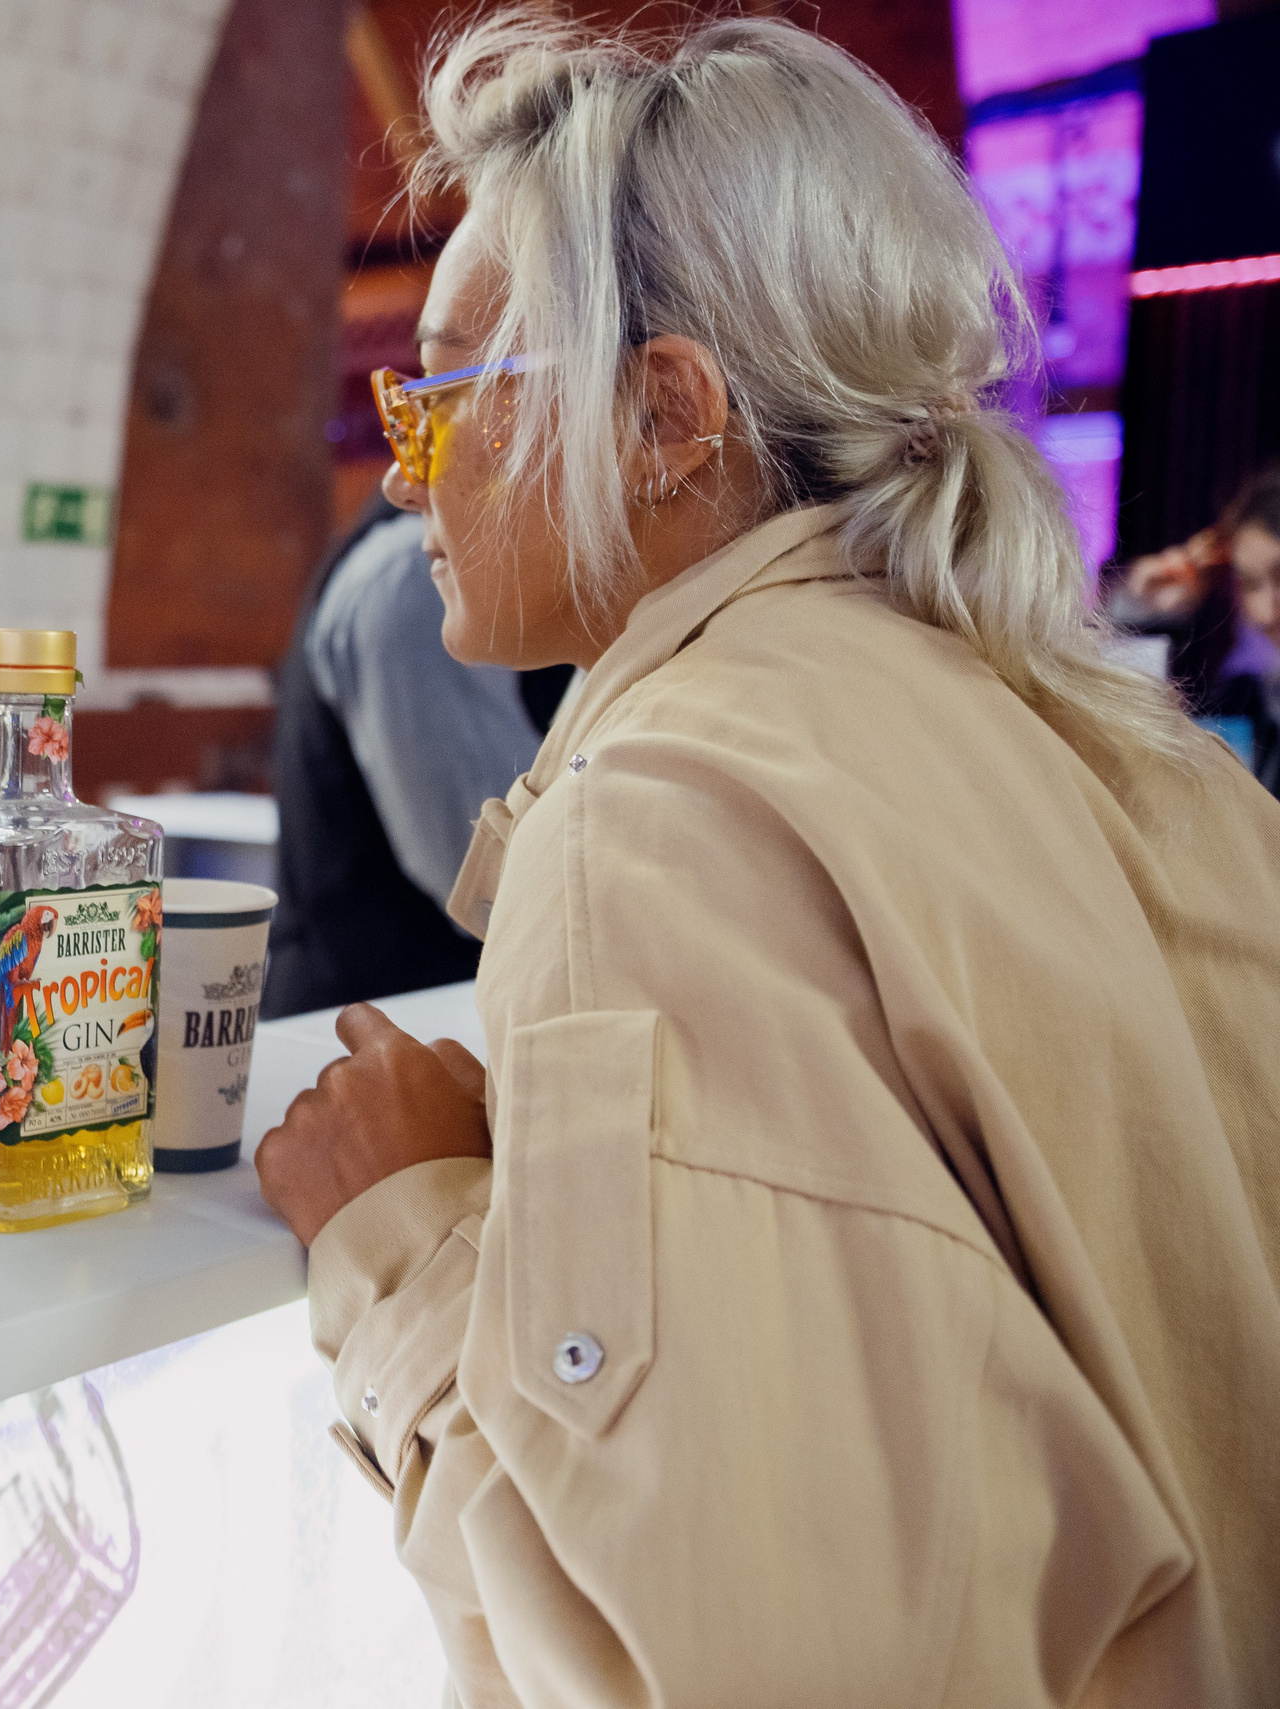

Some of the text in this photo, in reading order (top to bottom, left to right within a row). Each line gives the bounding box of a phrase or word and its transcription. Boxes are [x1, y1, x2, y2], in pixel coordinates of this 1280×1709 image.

[56, 928, 126, 958] BARRISTER
[12, 957, 155, 1039] Tropical
[62, 1019, 115, 1052] GIN
